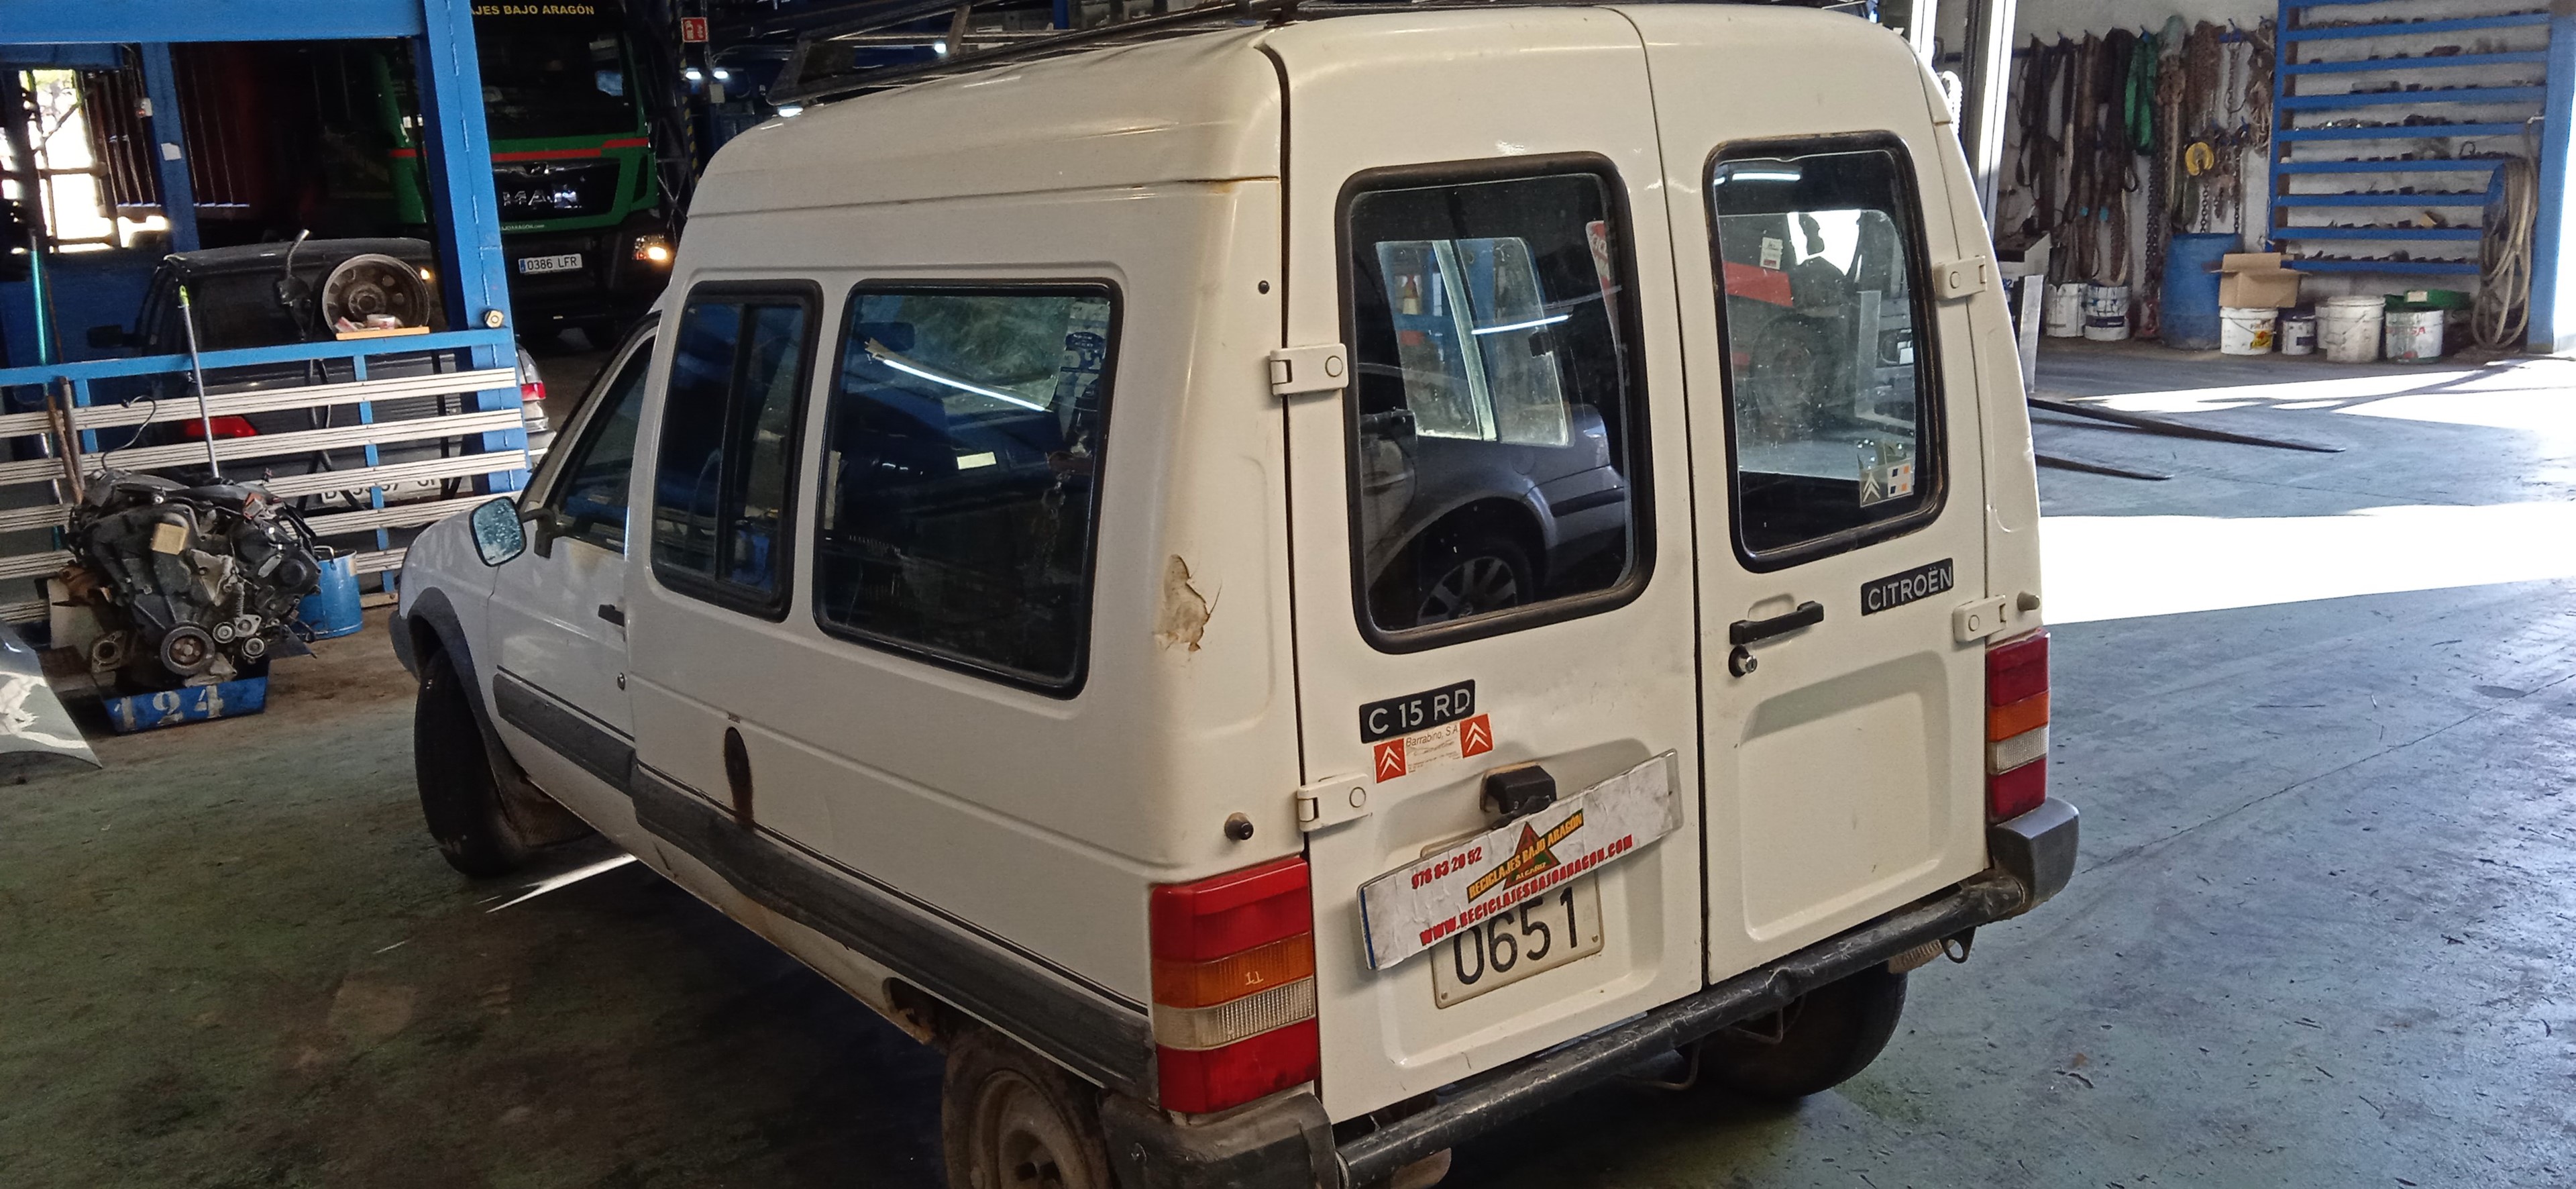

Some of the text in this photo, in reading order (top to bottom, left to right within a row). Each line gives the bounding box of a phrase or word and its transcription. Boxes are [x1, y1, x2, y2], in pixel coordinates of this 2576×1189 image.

[503, 5, 538, 15] BAJO
[542, 4, 594, 15] ARAGÓN
[527, 256, 577, 270] 0386 LFR
[1868, 566, 1952, 611] CITROËN
[1368, 688, 1470, 734] C 15 RD
[1451, 853, 1466, 873] 20
[1467, 846, 1482, 865] 52
[1468, 813, 1582, 899] RECICLAJES BAJO ARAGÓN
[1453, 887, 1578, 986] 0651
